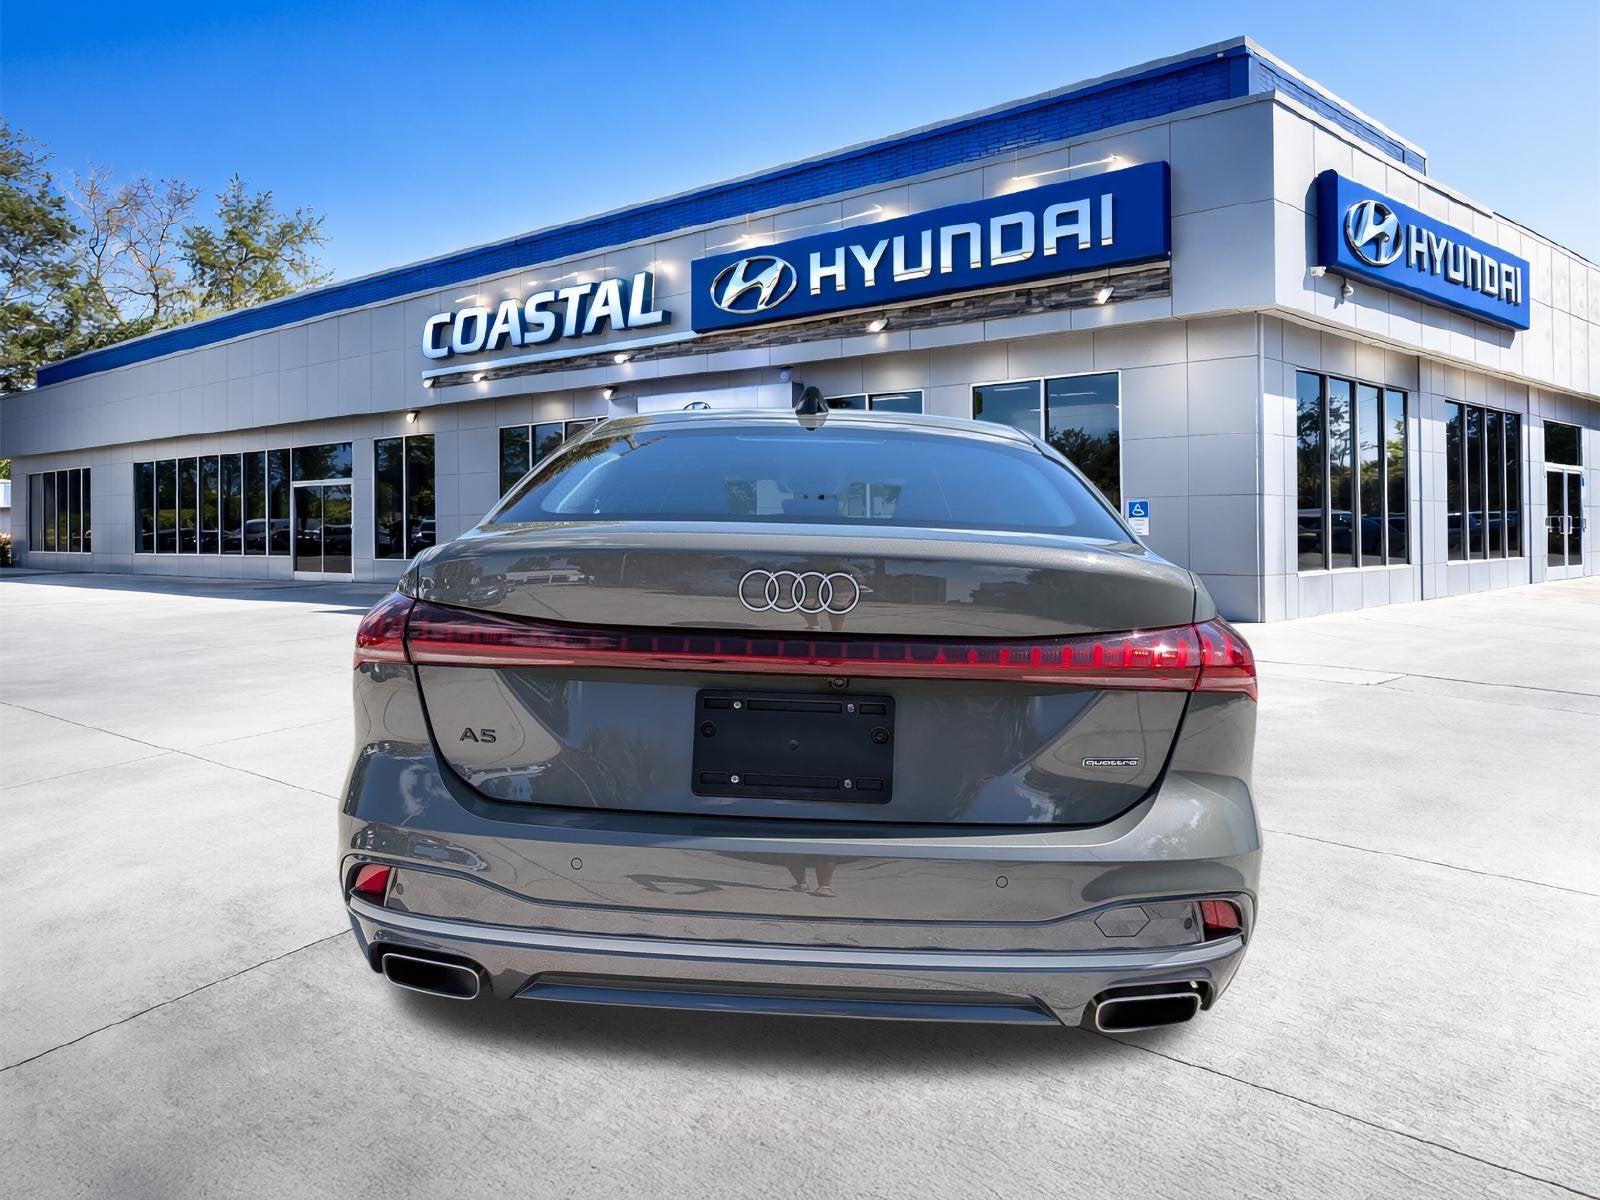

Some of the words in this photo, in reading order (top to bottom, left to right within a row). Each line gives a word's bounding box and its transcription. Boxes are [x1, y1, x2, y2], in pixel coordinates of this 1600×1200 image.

[809, 193, 1114, 295] HYUNDAI
[1407, 224, 1522, 306] HYUNDAI
[422, 271, 668, 360] COASTAL
[459, 727, 497, 743] A5
[1084, 758, 1138, 768] quattro
